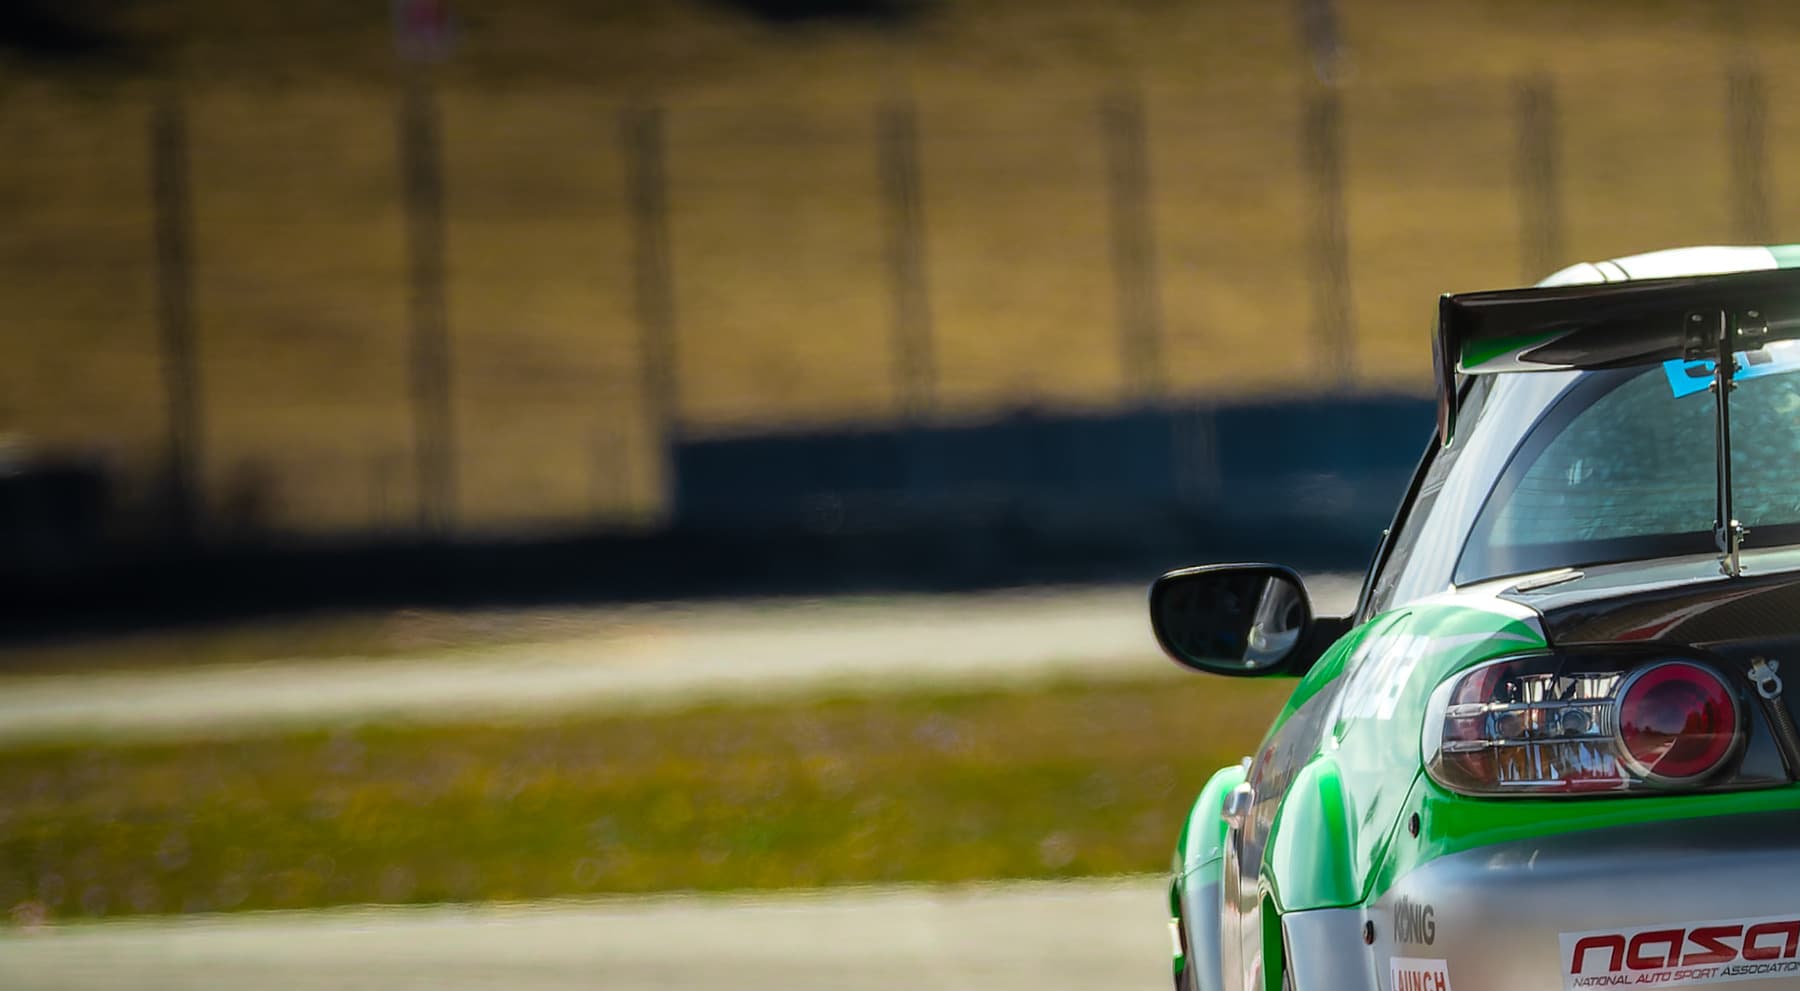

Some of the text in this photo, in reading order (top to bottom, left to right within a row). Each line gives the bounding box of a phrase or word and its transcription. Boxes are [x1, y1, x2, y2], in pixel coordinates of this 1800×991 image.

[1393, 894, 1436, 946] KÖNIG
[1572, 974, 1633, 987] NATIONAL
[1635, 971, 1673, 985] AUTO
[1673, 967, 1719, 981] SPORT
